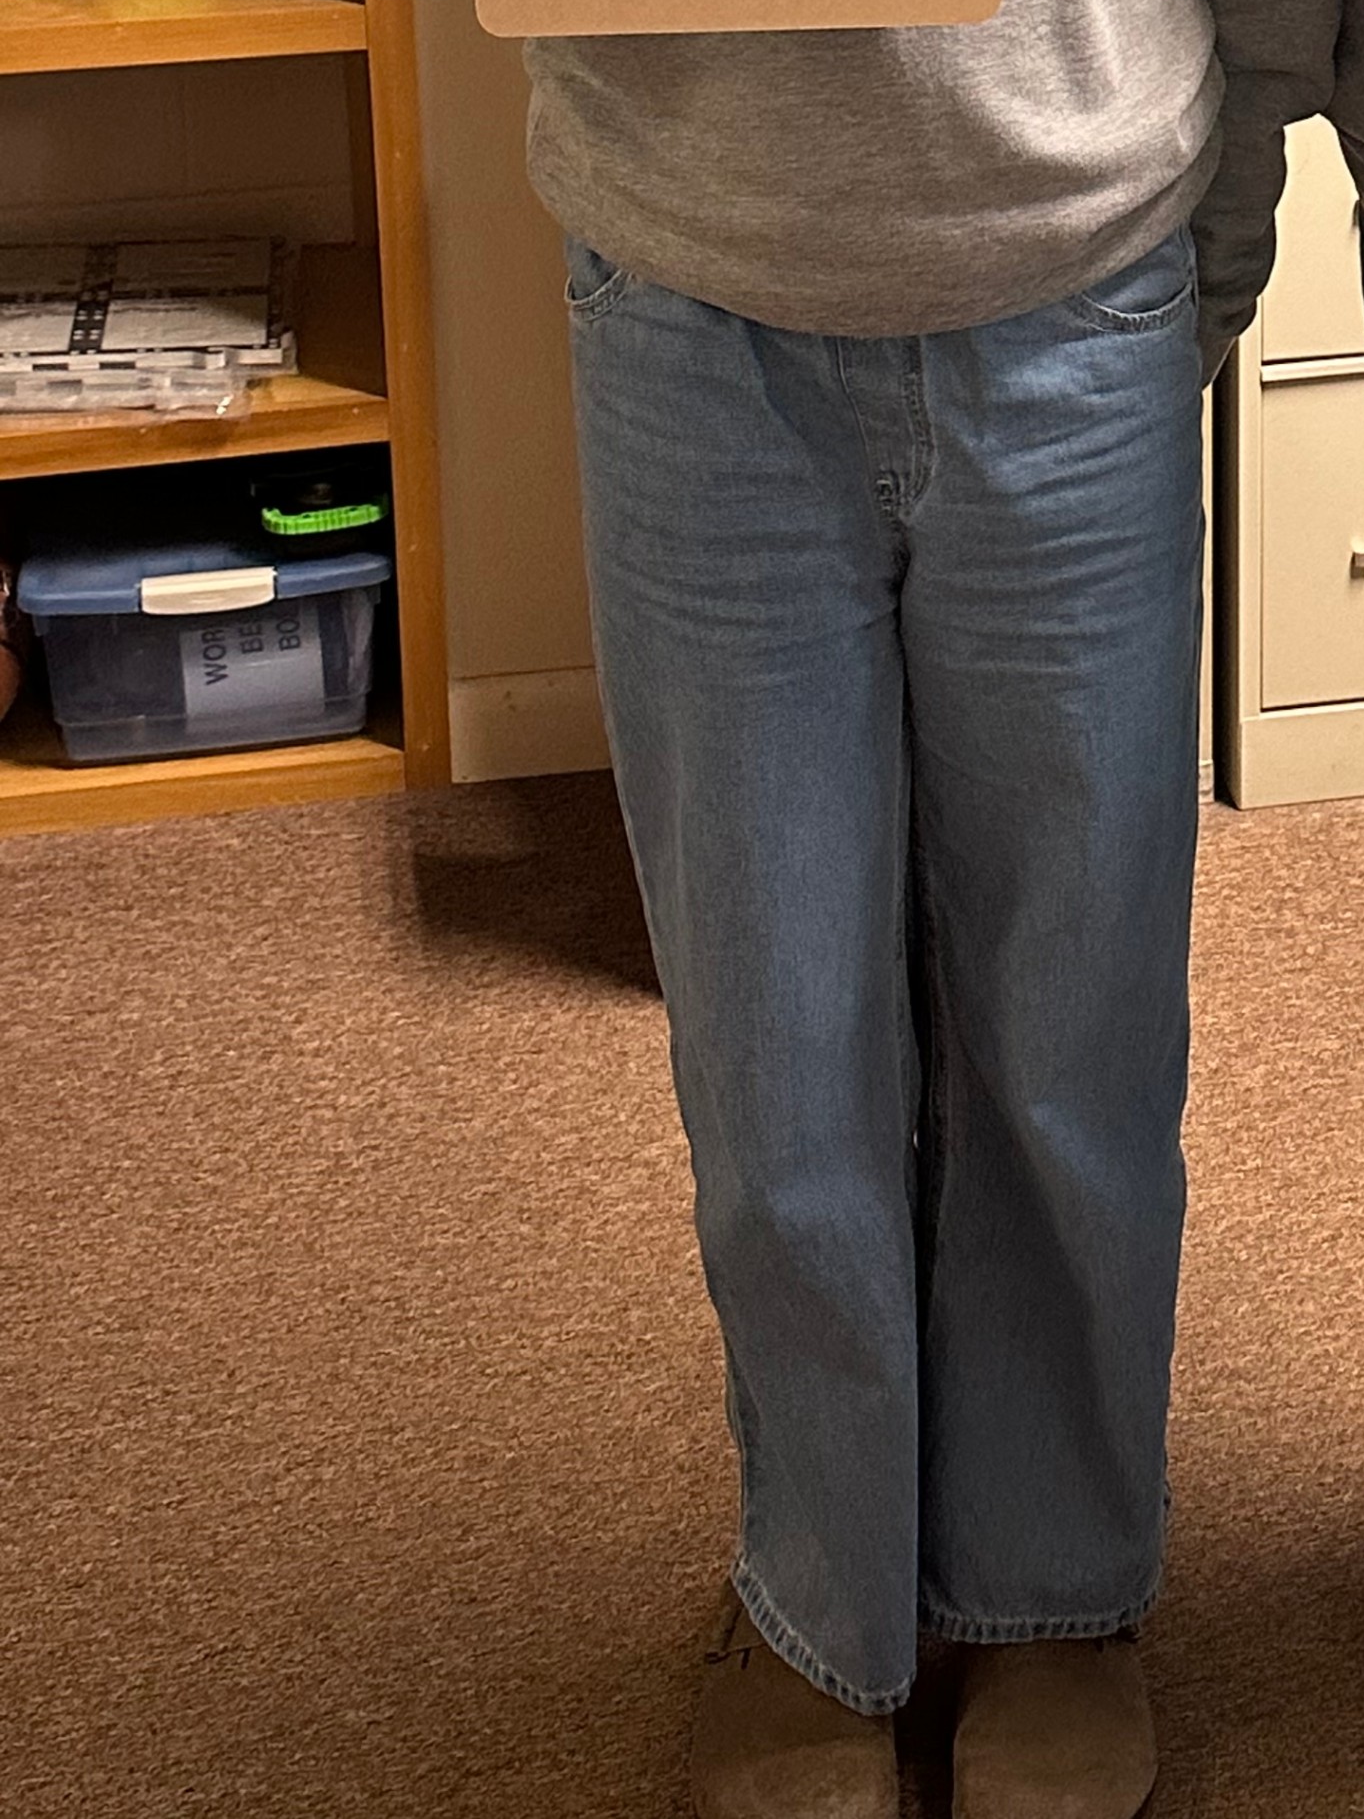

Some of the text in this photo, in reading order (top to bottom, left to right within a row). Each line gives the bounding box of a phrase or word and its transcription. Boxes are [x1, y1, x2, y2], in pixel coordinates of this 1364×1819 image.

[239, 620, 264, 654] BE
[275, 618, 301, 652] BO
[201, 628, 229, 686] WOR
